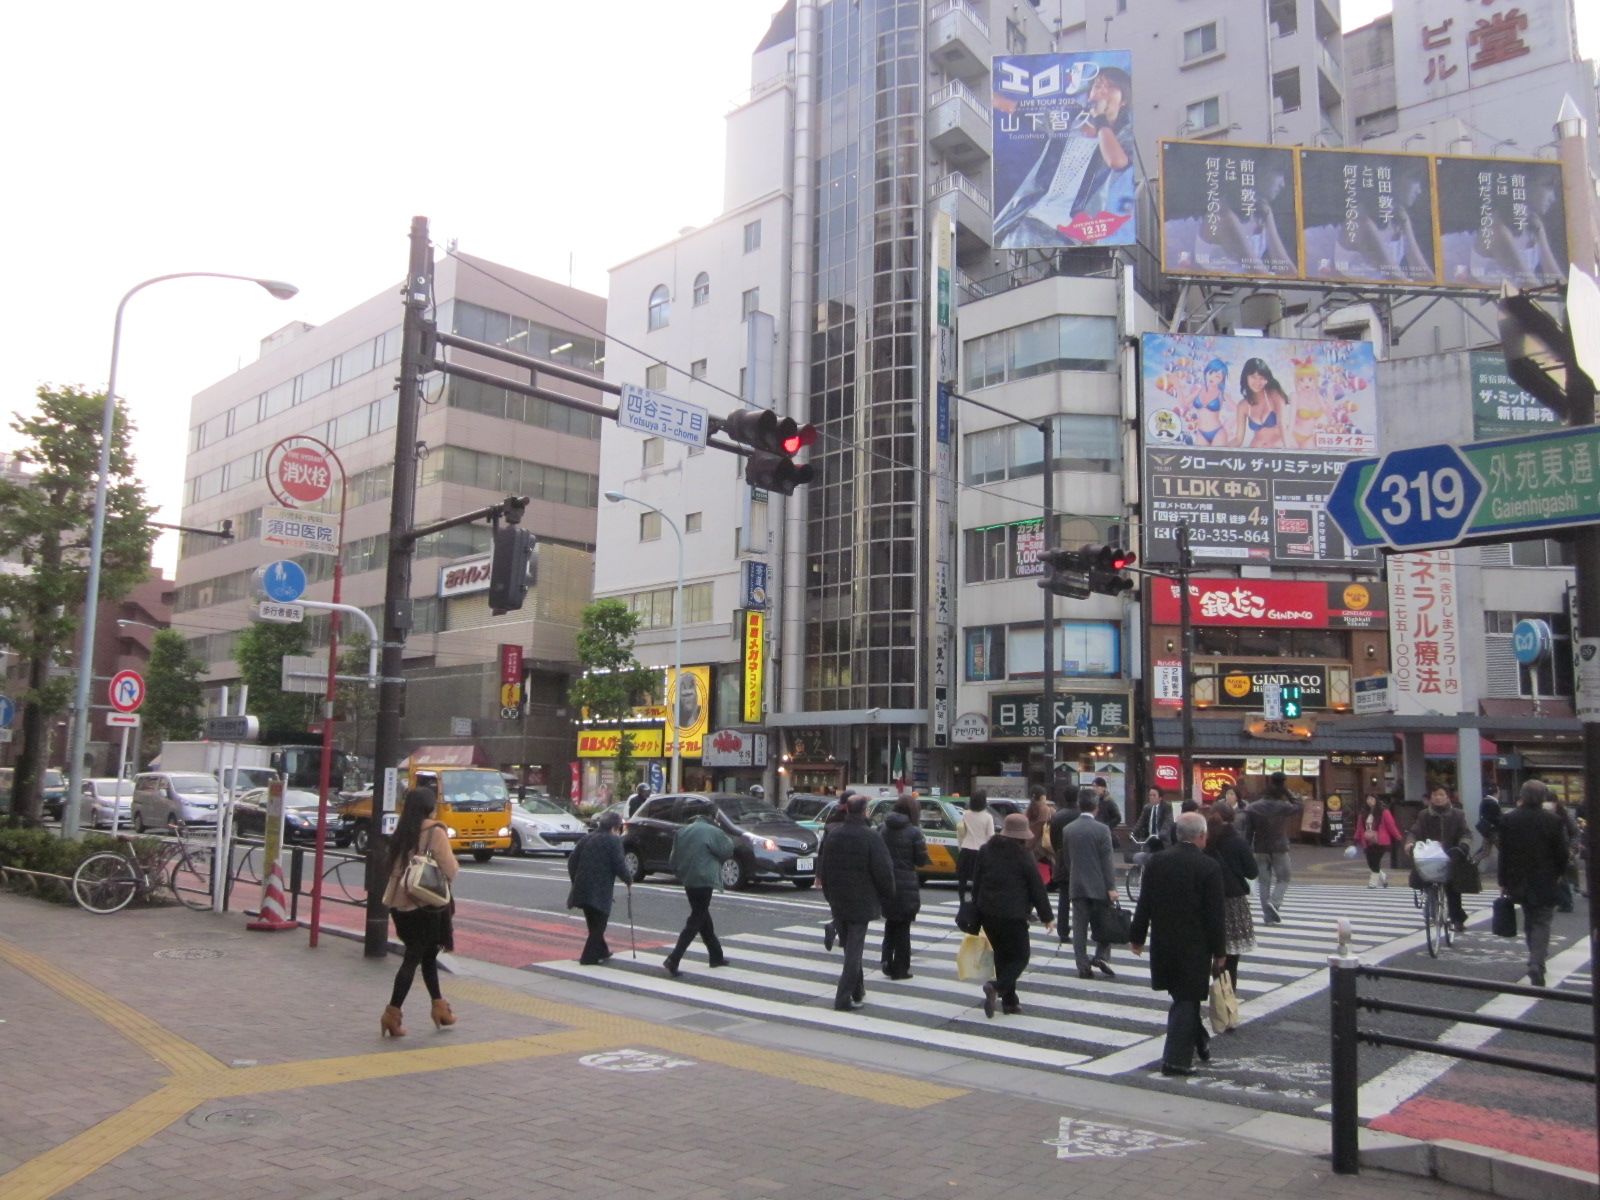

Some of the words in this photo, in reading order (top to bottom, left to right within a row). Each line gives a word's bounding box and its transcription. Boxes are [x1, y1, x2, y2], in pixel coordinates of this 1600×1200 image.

[1468, 0, 1531, 71] 堂
[1020, 99, 1036, 107] LIVE
[1001, 110, 1096, 132] 山下智久
[1225, 158, 1237, 181] とは
[1362, 165, 1374, 188] とは
[1240, 159, 1256, 217] 前田敦子
[1377, 166, 1394, 224] 前田敦子
[1497, 172, 1508, 195] とは
[1510, 174, 1529, 231] 前田敦子
[1082, 223, 1107, 236] 12.12
[1479, 389, 1536, 405] ザ・ミッド
[627, 394, 702, 431] 四谷三丁目
[628, 414, 659, 431] Yotsuya
[1497, 406, 1554, 422] 新宿御苑
[283, 460, 328, 488] 消火栓
[1180, 456, 1246, 471] グローベル
[1489, 442, 1600, 494] 外苑東通
[1224, 481, 1262, 498] 中心
[1381, 467, 1465, 526] 319
[267, 519, 333, 543] 須田医院
[1017, 523, 1044, 534] カラオ
[1172, 528, 1271, 543] 20-335-864
[262, 607, 300, 619] 歩行者優先
[1200, 586, 1265, 619] 銀だこ
[1267, 609, 1313, 620] GINDACO
[954, 727, 986, 737] アゼリアビル
